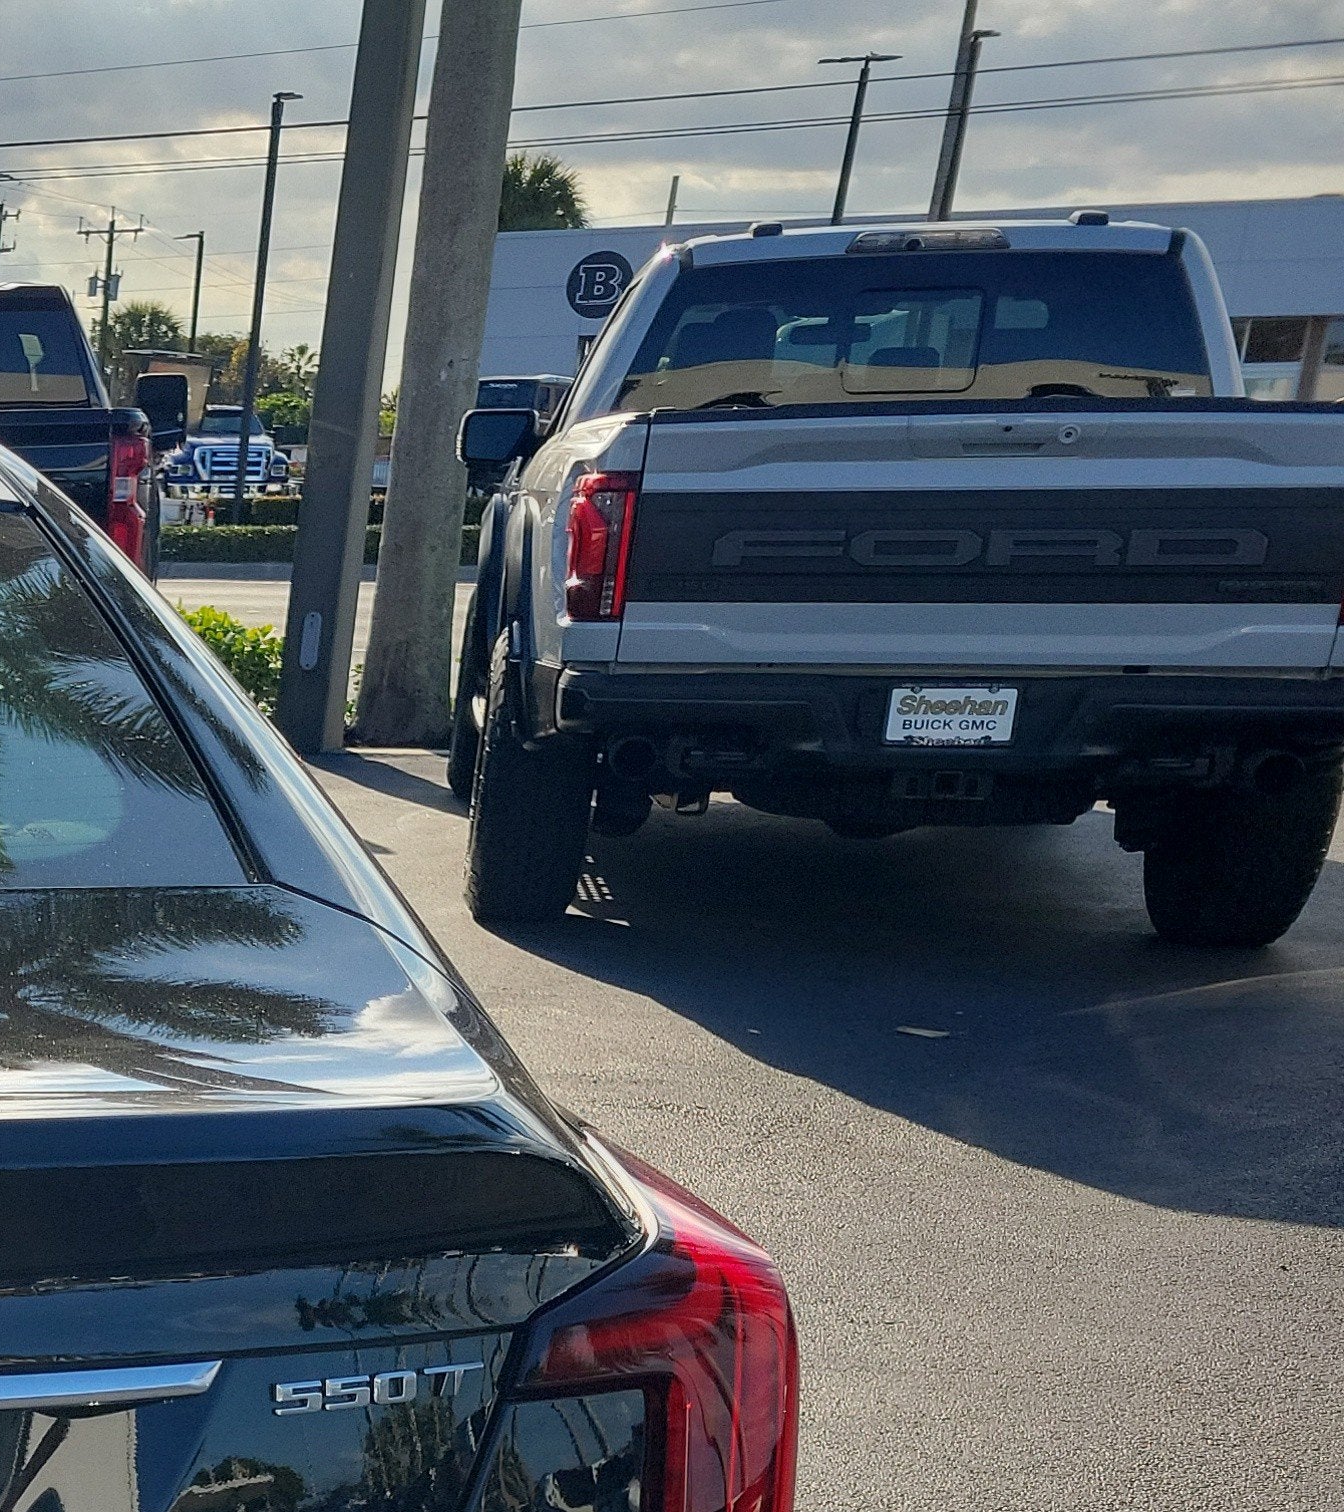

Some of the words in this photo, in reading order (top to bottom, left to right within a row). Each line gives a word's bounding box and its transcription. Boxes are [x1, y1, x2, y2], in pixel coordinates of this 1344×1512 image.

[575, 264, 622, 306] B
[712, 528, 1268, 567] FORD
[896, 694, 1009, 716] Sheehan
[902, 719, 954, 730] BUICK
[958, 719, 998, 730] GMC
